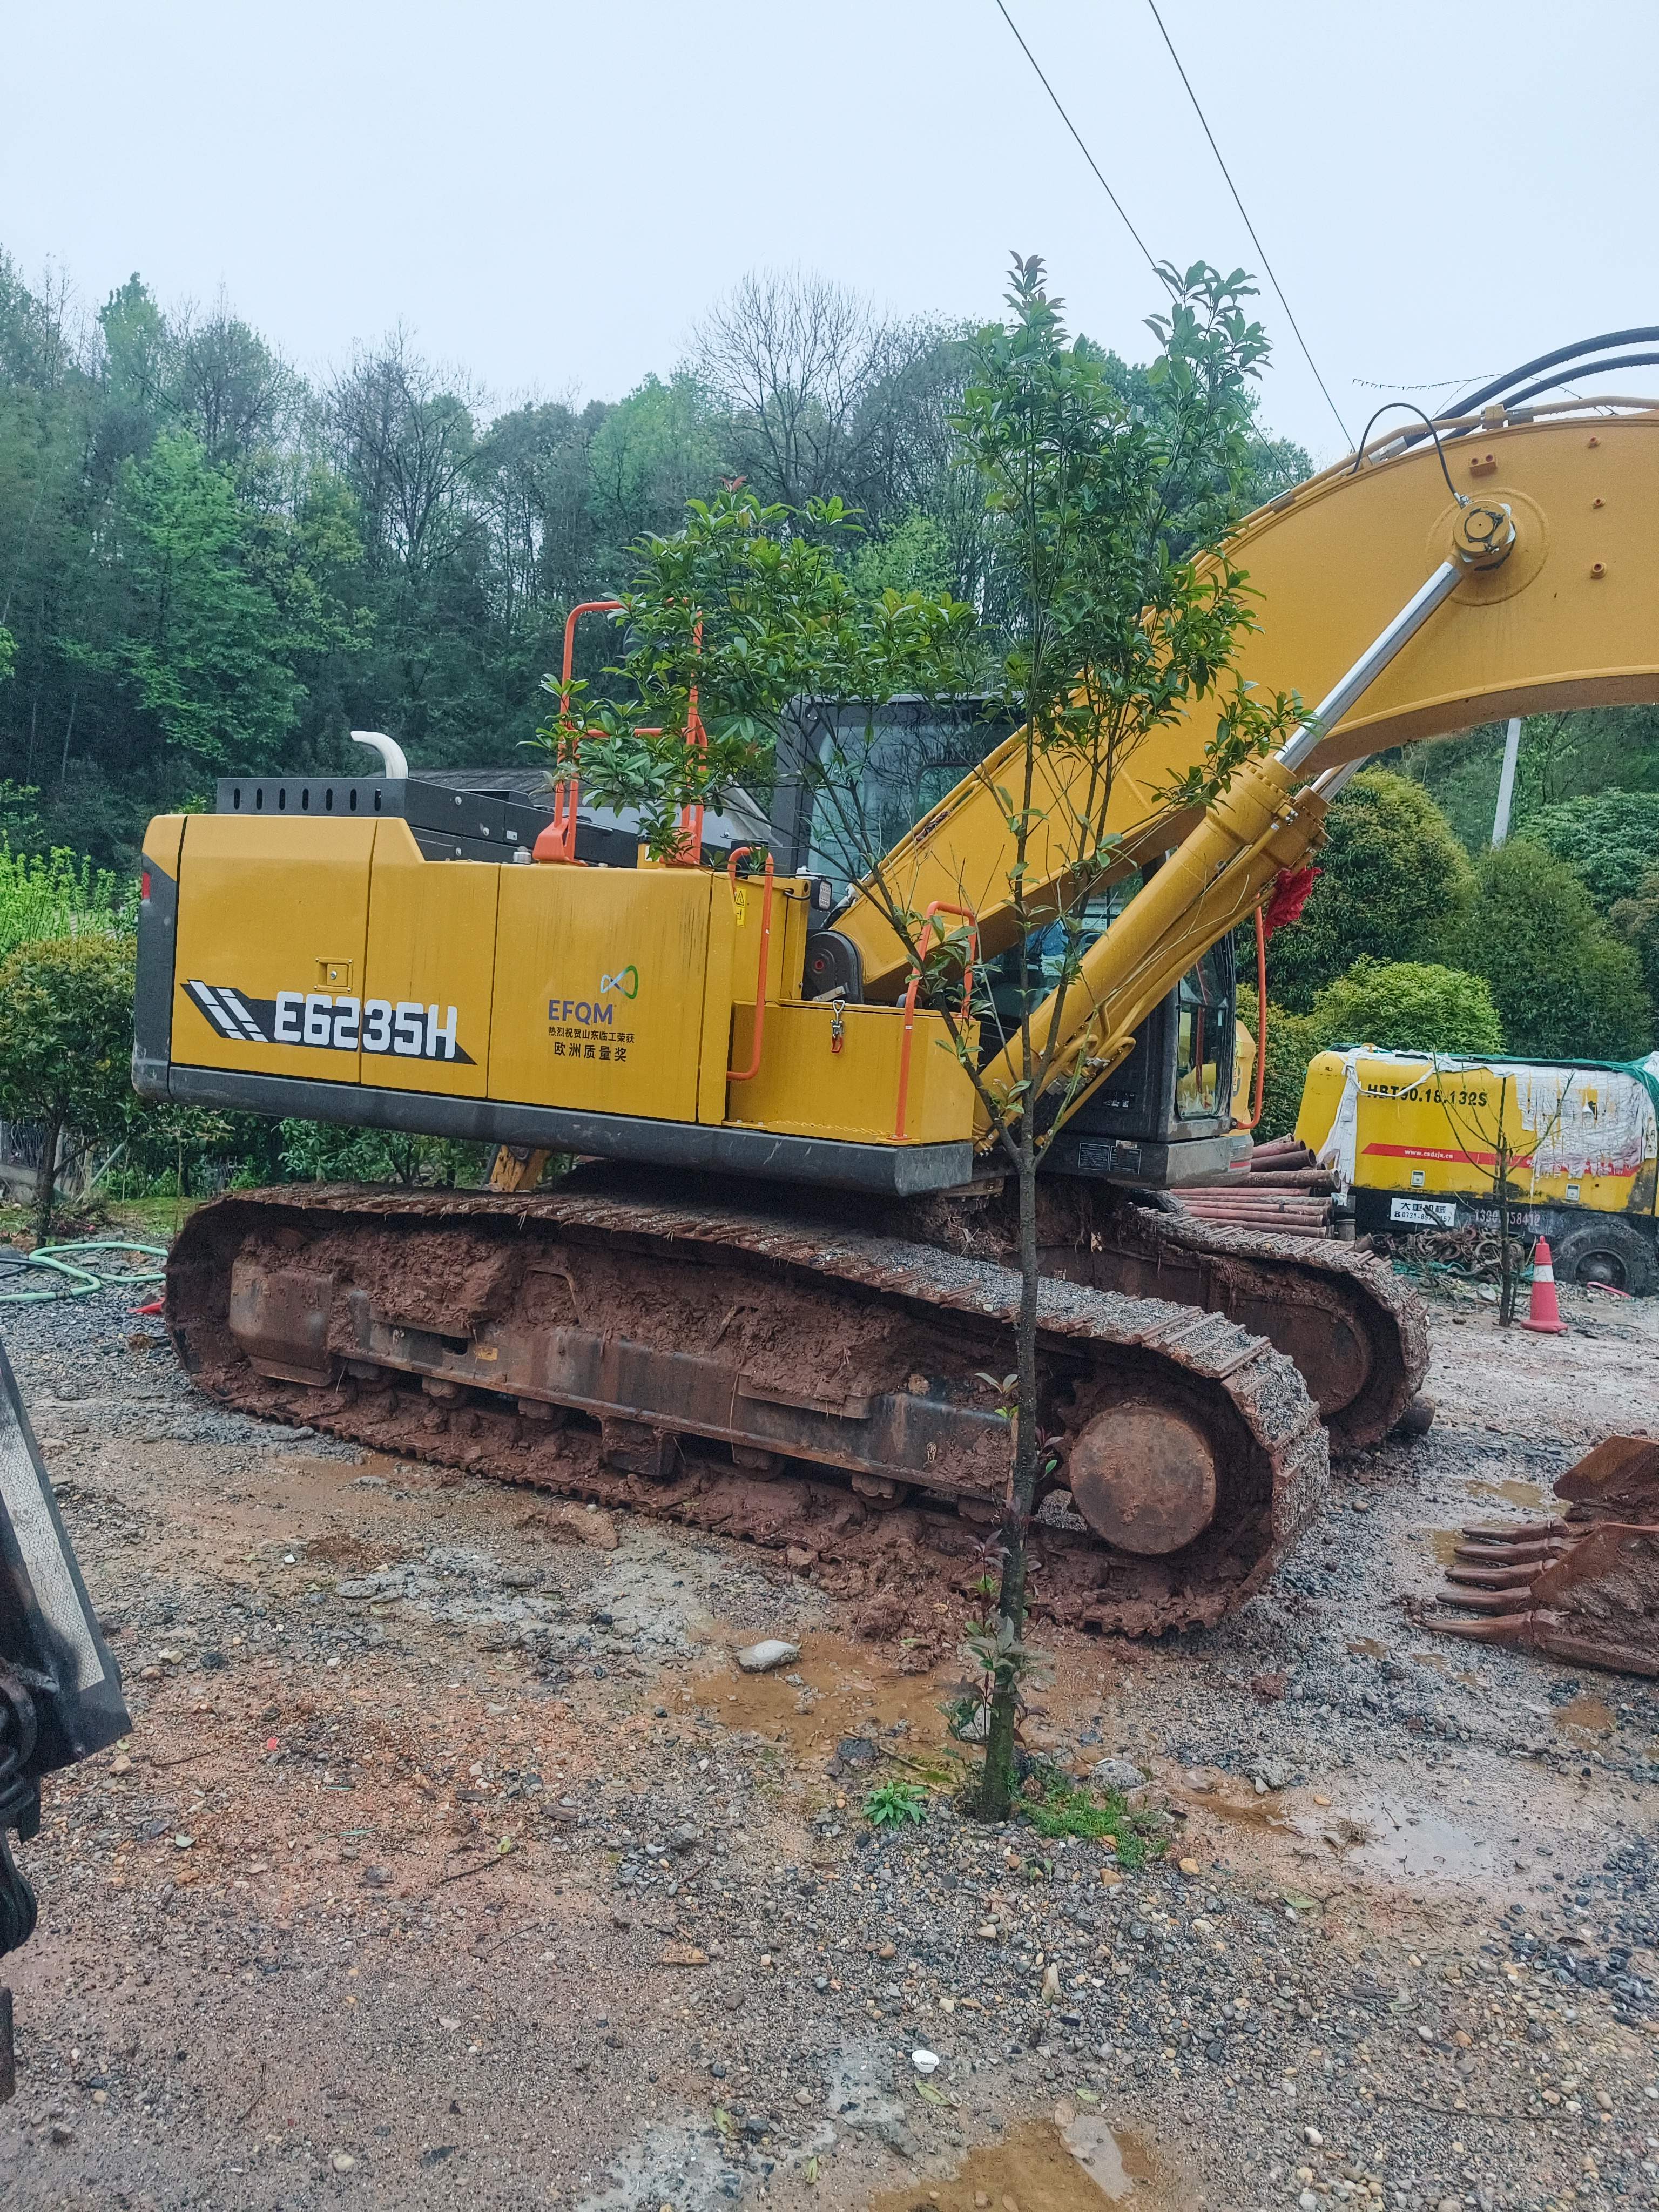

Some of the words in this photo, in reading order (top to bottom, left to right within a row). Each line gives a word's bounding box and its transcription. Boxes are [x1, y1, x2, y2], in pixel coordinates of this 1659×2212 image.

[548, 999, 613, 1025] EFQM
[274, 991, 457, 1059] E6235H
[548, 1026, 635, 1043] 热烈祝贺山东临工荣获
[554, 1042, 627, 1062] 欧洲质量奖
